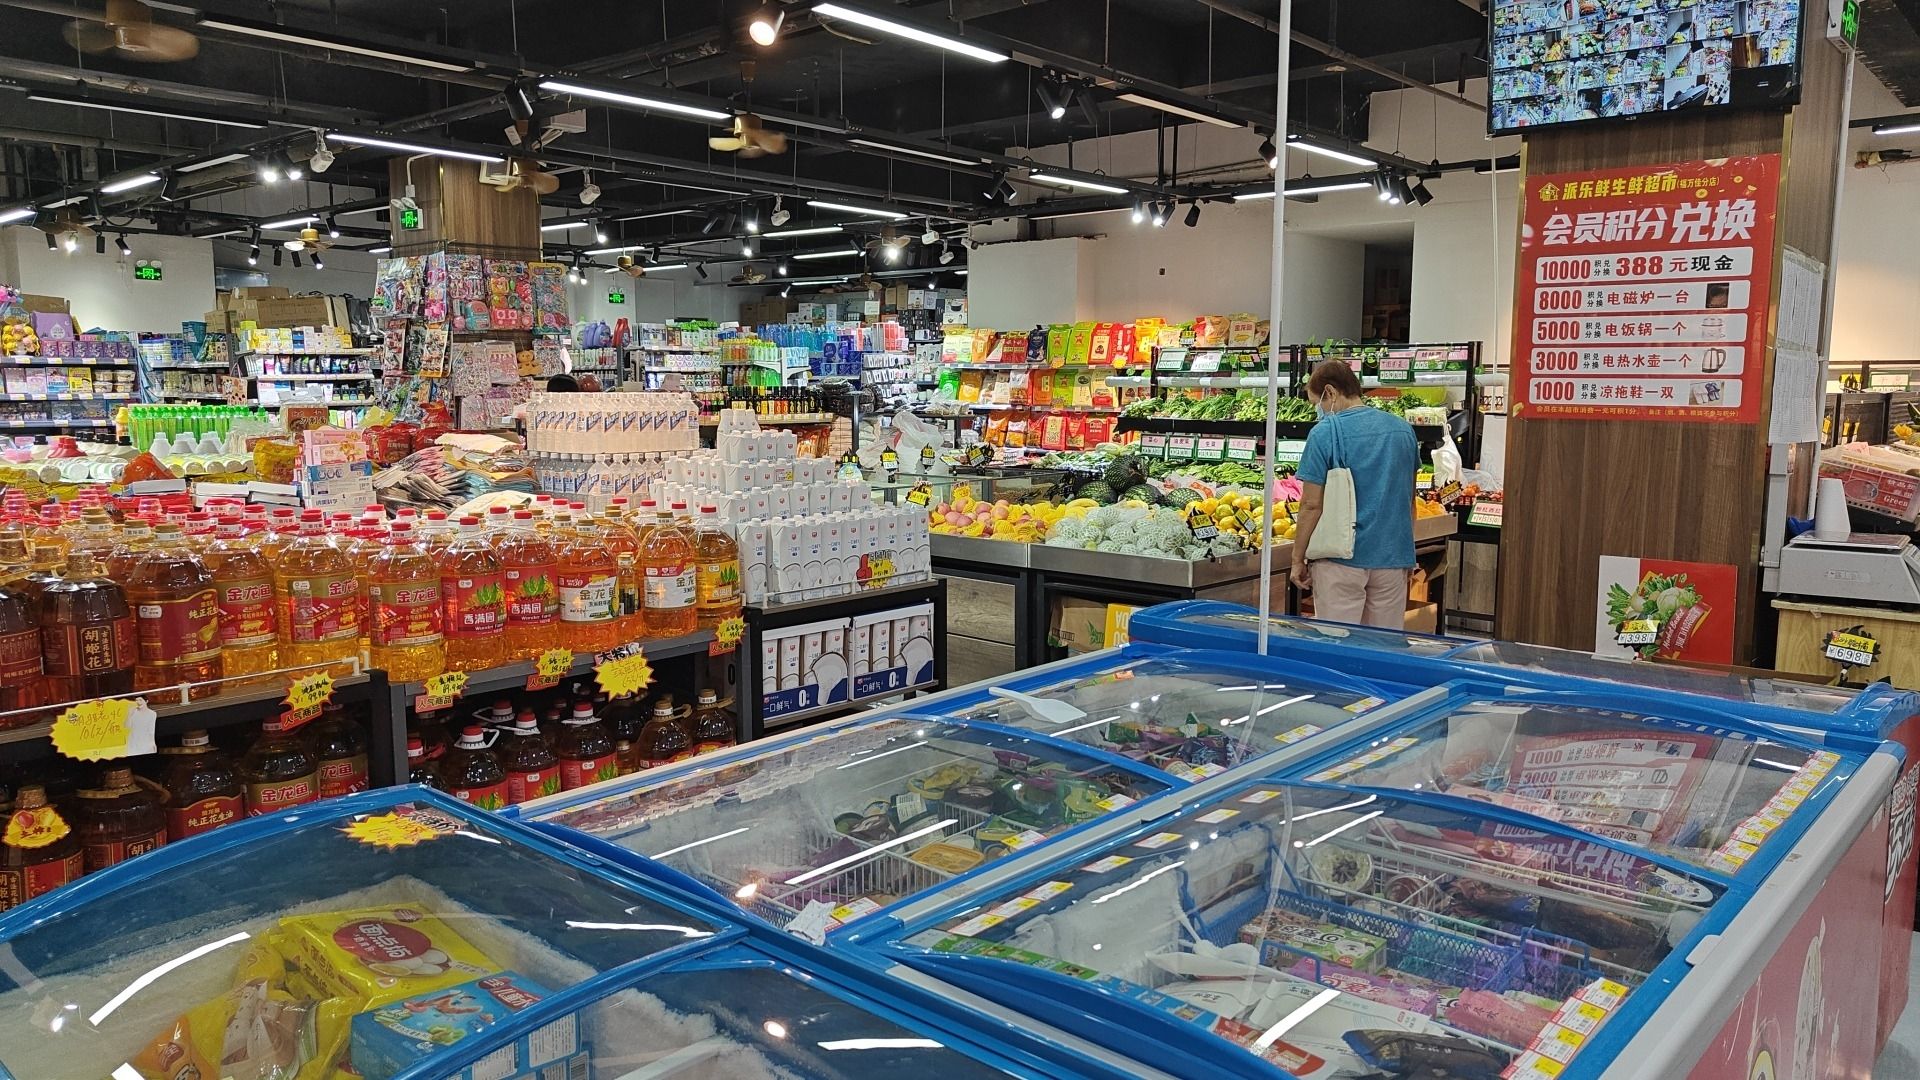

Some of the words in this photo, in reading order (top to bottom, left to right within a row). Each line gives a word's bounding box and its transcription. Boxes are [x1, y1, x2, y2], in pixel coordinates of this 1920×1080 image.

[1562, 174, 1678, 200] 派乐鲜生鲜超市
[1542, 198, 1757, 246] 会员积分兑换
[1541, 259, 1591, 281] 10000
[1615, 256, 1664, 276] 388
[1539, 289, 1582, 310] 8000
[1607, 290, 1690, 305] 电磁炉一台
[1537, 320, 1580, 341] 5000
[1605, 322, 1688, 337] 电饭锅一个
[1535, 351, 1578, 371] 3000
[1603, 353, 1693, 369] 电热水壶一个
[1533, 381, 1575, 401] 1000
[1600, 385, 1675, 400] 凉拖鞋一双
[1883, 495, 1909, 507] Green
[226, 583, 272, 603] 金龙鱼
[396, 586, 439, 604] 金龙鱼
[464, 611, 495, 625] 香满园
[511, 602, 542, 615] 香满园
[84, 629, 102, 669] 胡姬花
[417, 695, 452, 710] 人气商品
[283, 704, 322, 728] 人气商品
[261, 782, 312, 803] 金龙鱼
[188, 810, 234, 828] 纯正花生油
